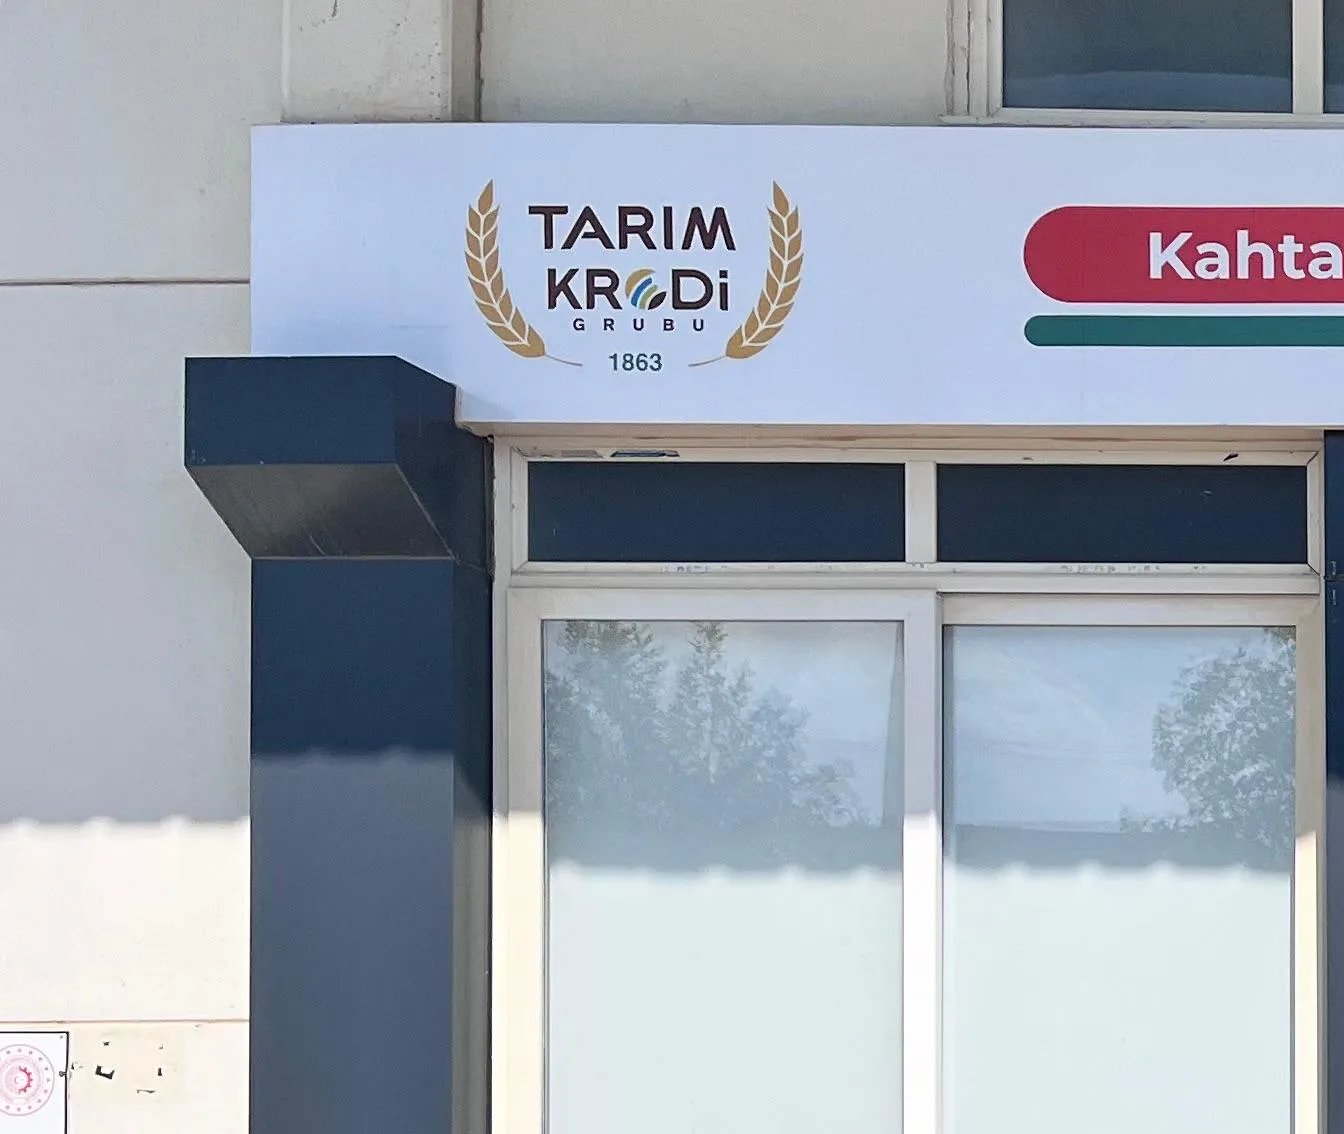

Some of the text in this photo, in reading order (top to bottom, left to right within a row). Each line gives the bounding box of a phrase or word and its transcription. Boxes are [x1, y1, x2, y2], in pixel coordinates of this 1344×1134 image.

[528, 205, 737, 251] TARIM
[1148, 229, 1344, 280] Kahta
[572, 317, 705, 332] GRUBU
[607, 352, 663, 372] 1863
